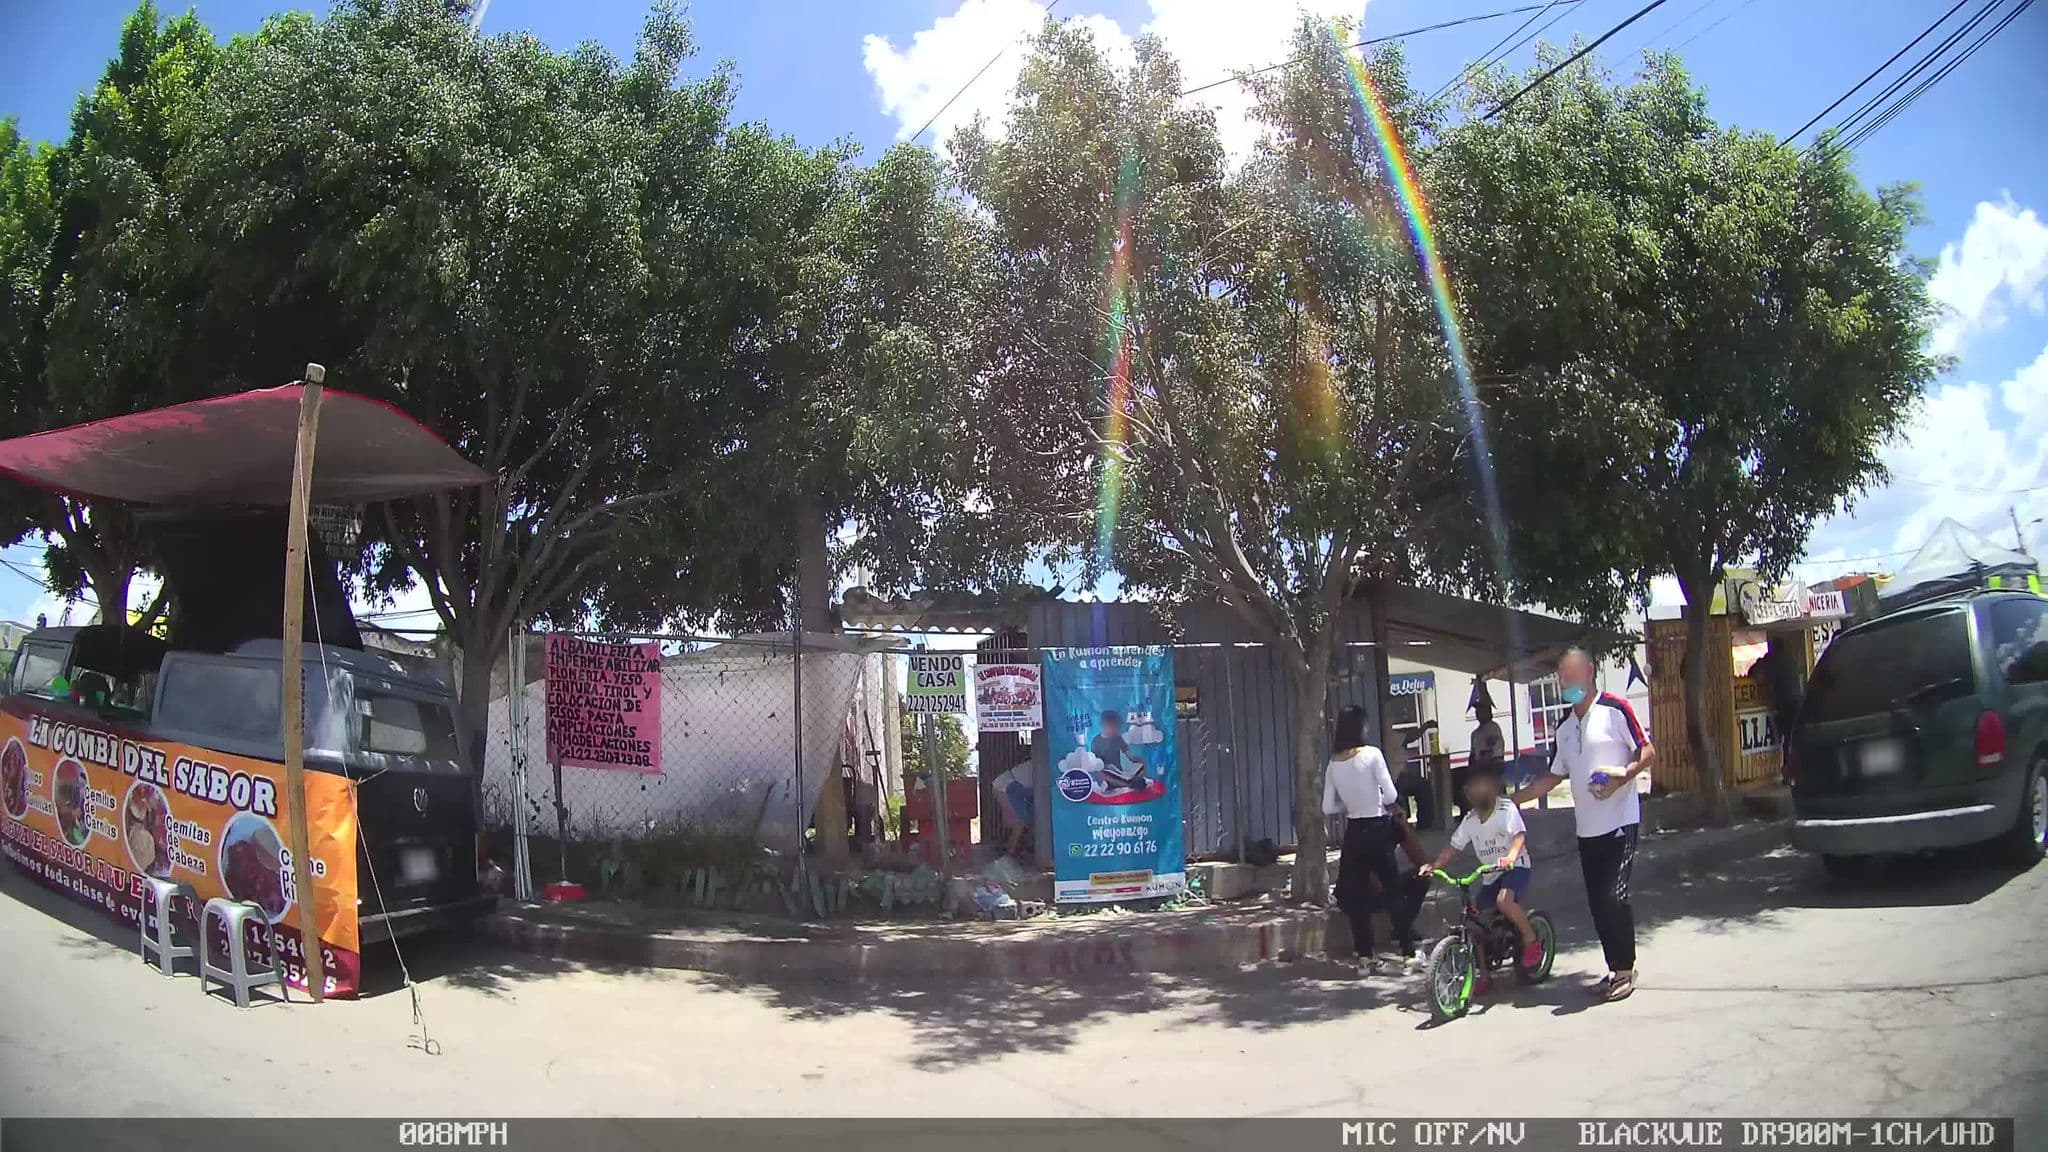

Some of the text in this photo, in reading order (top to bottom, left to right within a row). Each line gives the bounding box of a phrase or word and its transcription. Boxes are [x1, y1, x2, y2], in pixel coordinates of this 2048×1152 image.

[1069, 647, 1109, 660] Kumon
[911, 656, 962, 672] VENDO
[1080, 656, 1142, 671] a aprender
[916, 672, 957, 688] CASA
[548, 693, 642, 712] COLOCACION DE
[908, 694, 966, 712] 2221252941
[588, 710, 625, 725] PASTA
[549, 718, 637, 738] AMPLIACIONES
[29, 715, 278, 819] LA COMBI DEL SABOR
[85, 803, 95, 814] de
[1087, 814, 1153, 826] Centro Kumon
[166, 816, 210, 843] Cemitas
[168, 833, 179, 847] de
[1084, 840, 1157, 857] 22 22 90 6176
[51, 837, 94, 879] SABOR
[168, 847, 205, 873] Cabeza
[281, 849, 325, 874] Cne
[44, 863, 70, 888] toda
[72, 879, 104, 904] clase
